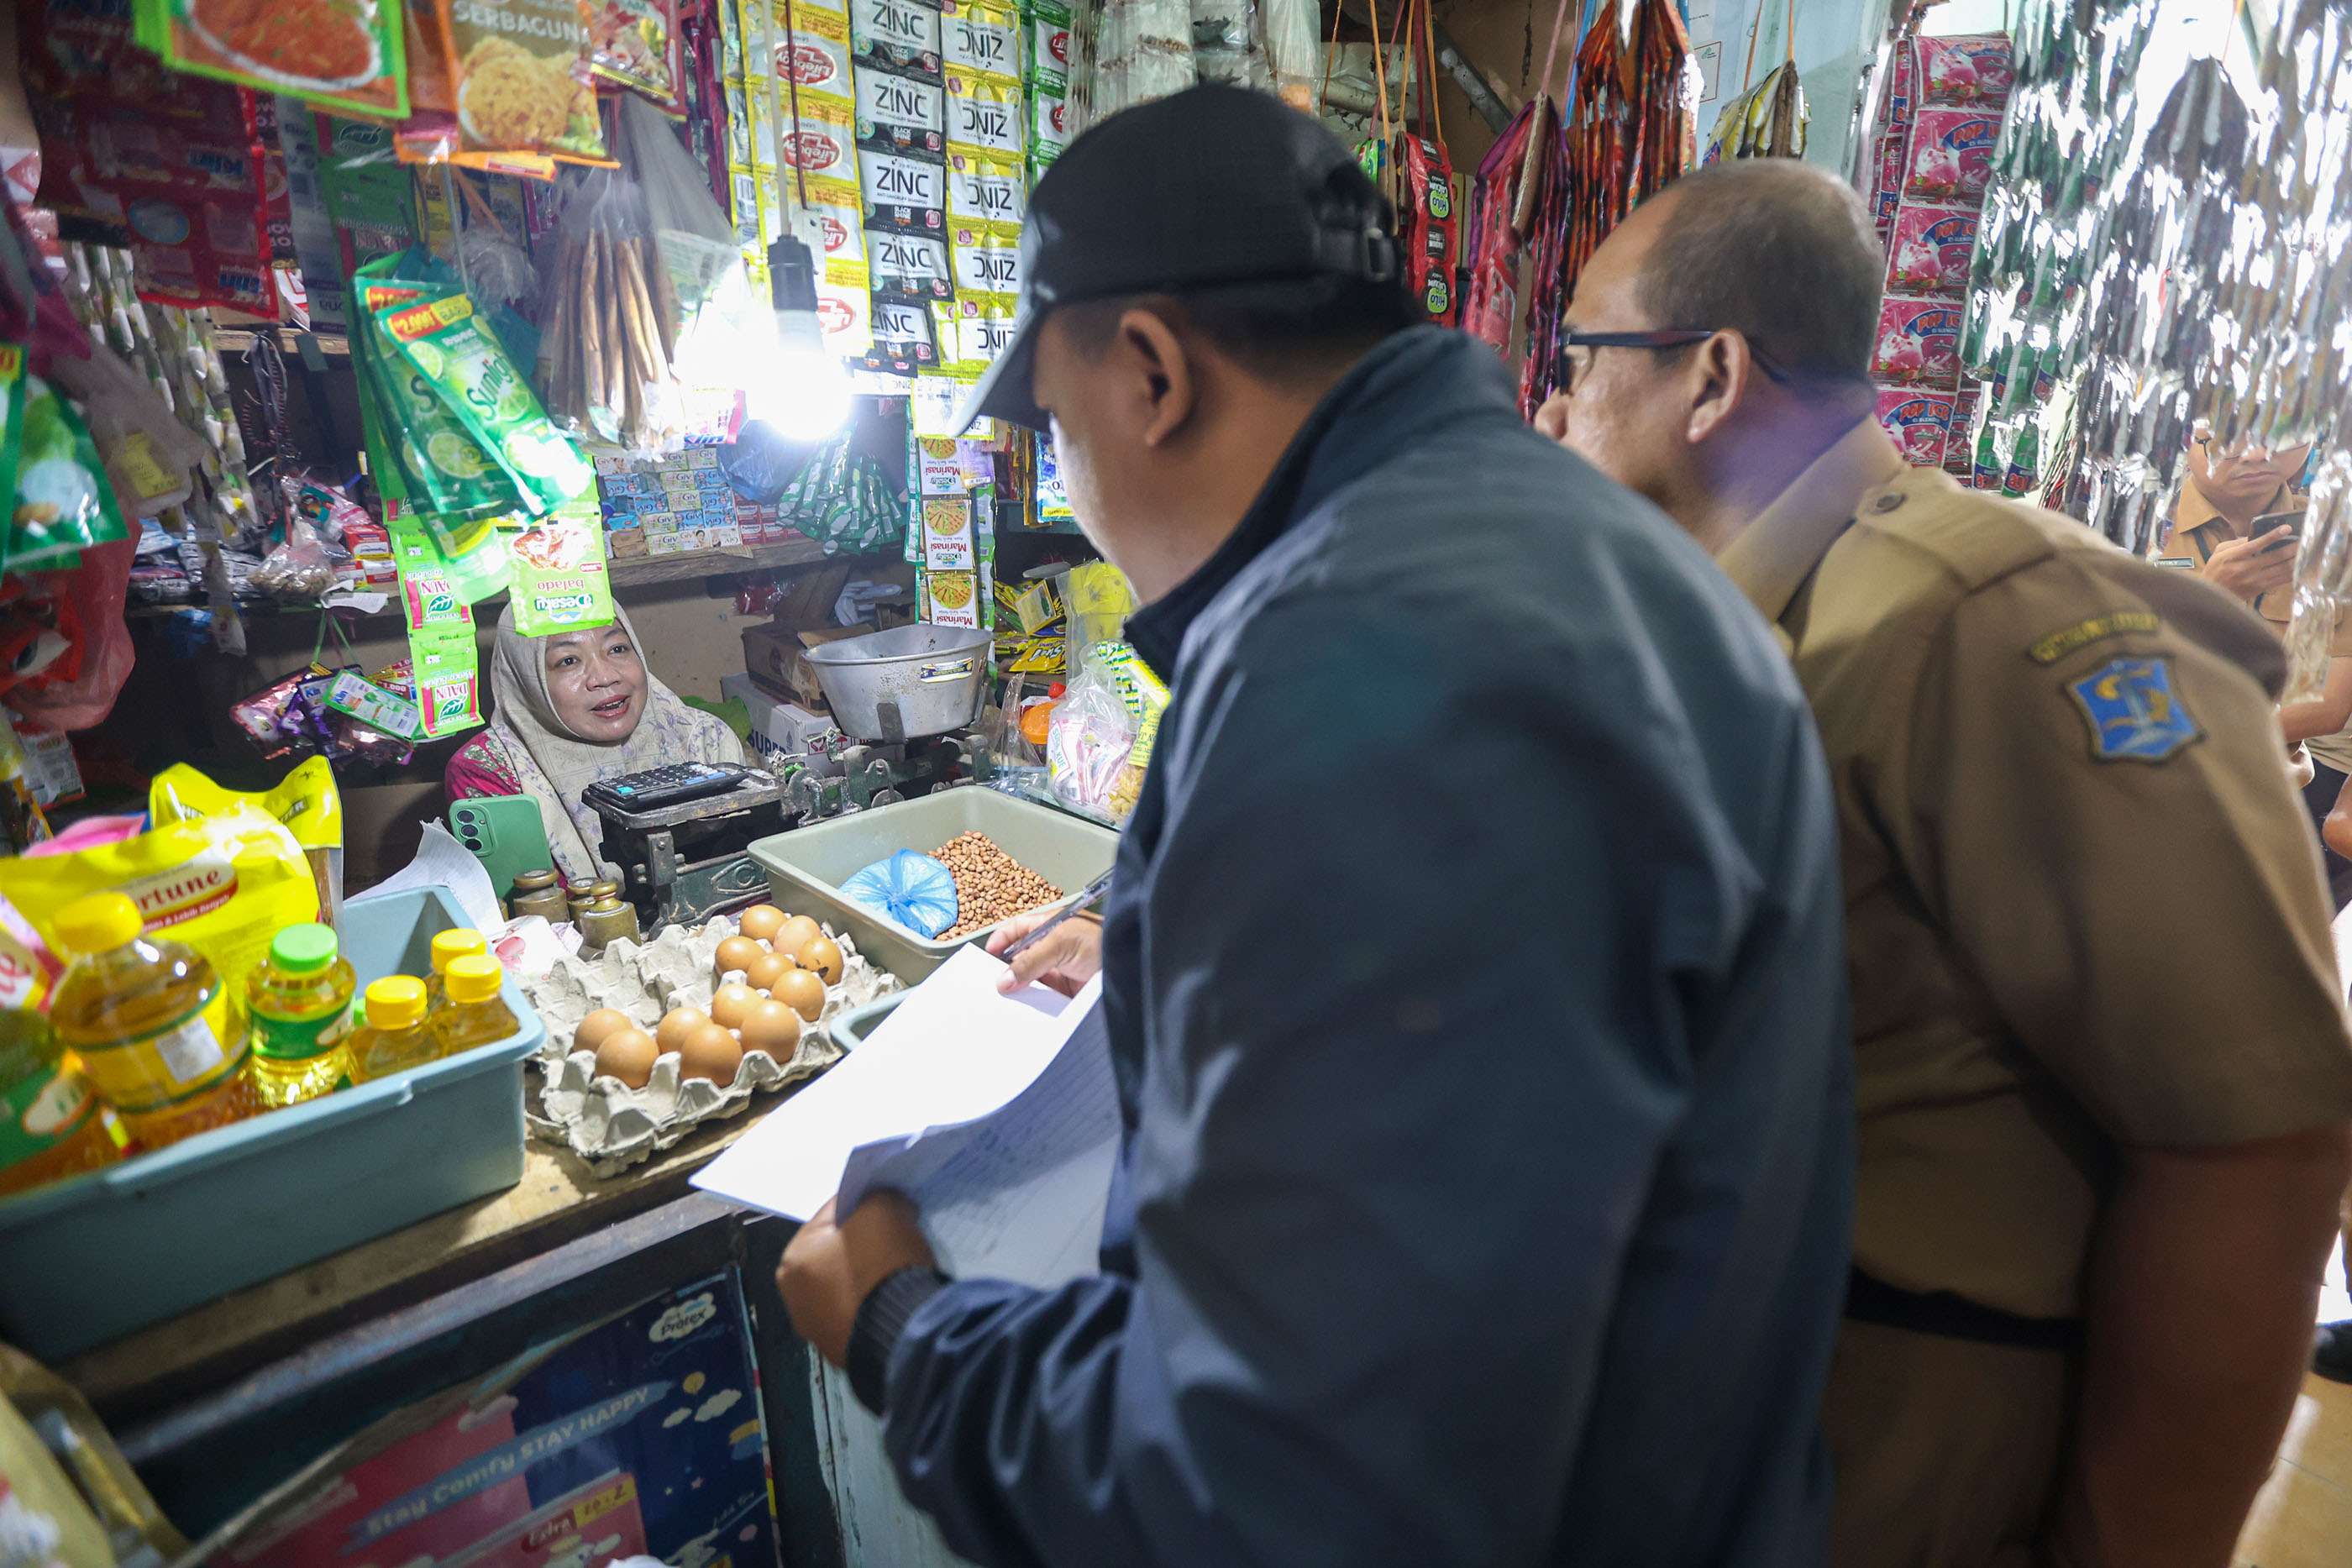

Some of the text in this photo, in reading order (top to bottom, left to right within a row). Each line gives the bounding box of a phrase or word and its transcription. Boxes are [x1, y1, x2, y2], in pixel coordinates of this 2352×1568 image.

[872, 0, 925, 39] ZINC
[958, 28, 1004, 60] ZINC
[776, 50, 832, 77] Lifeboy
[874, 77, 928, 119] ZINC
[963, 107, 1008, 138] ZINC
[1953, 123, 1986, 146] POP
[783, 136, 837, 163] Lifeboy
[877, 158, 929, 198] ZINC
[968, 183, 1013, 211] ZINC
[1935, 221, 1961, 242] POP
[879, 235, 932, 269] ZINC
[973, 257, 1017, 281] ZINC
[1918, 312, 1962, 333] POP IC
[1899, 402, 1950, 422] POP ICE
[676, 473, 692, 482] Giv
[926, 467, 961, 476] Marinasi
[682, 493, 698, 502] Giv
[658, 515, 672, 525] Giv
[663, 535, 679, 545] Giv
[930, 543, 967, 552] Marinasi
[537, 578, 585, 591] balado
[534, 594, 593, 611] Desaku
[937, 616, 973, 626] Marinasi
[435, 682, 468, 702] DAUN
[139, 869, 223, 911] rtune
[520, 1426, 575, 1460] STAY
[580, 1387, 649, 1430] HAPPY
